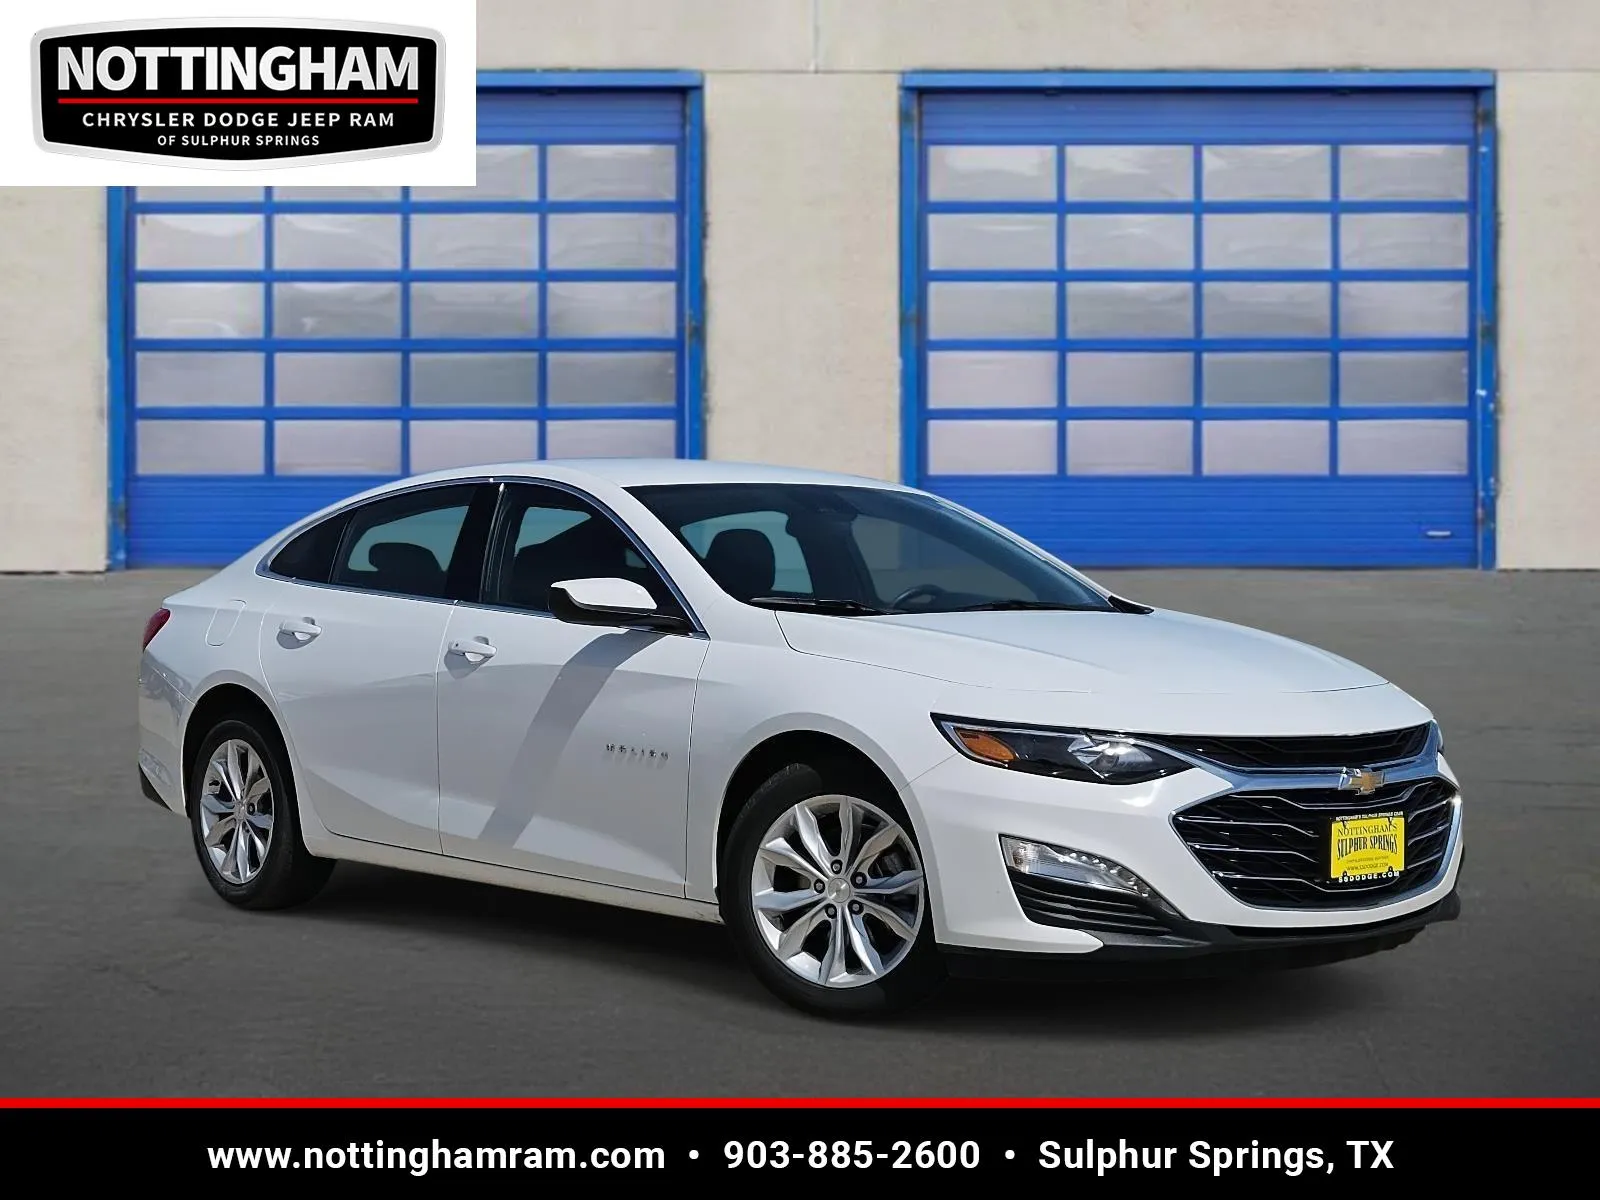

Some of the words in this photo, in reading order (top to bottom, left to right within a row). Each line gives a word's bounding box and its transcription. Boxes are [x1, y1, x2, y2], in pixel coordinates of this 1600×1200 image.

[1338, 823, 1398, 836] NOTTINGHAM'S
[1337, 836, 1368, 860] SULPHUR
[1370, 834, 1397, 854] SPRINGS
